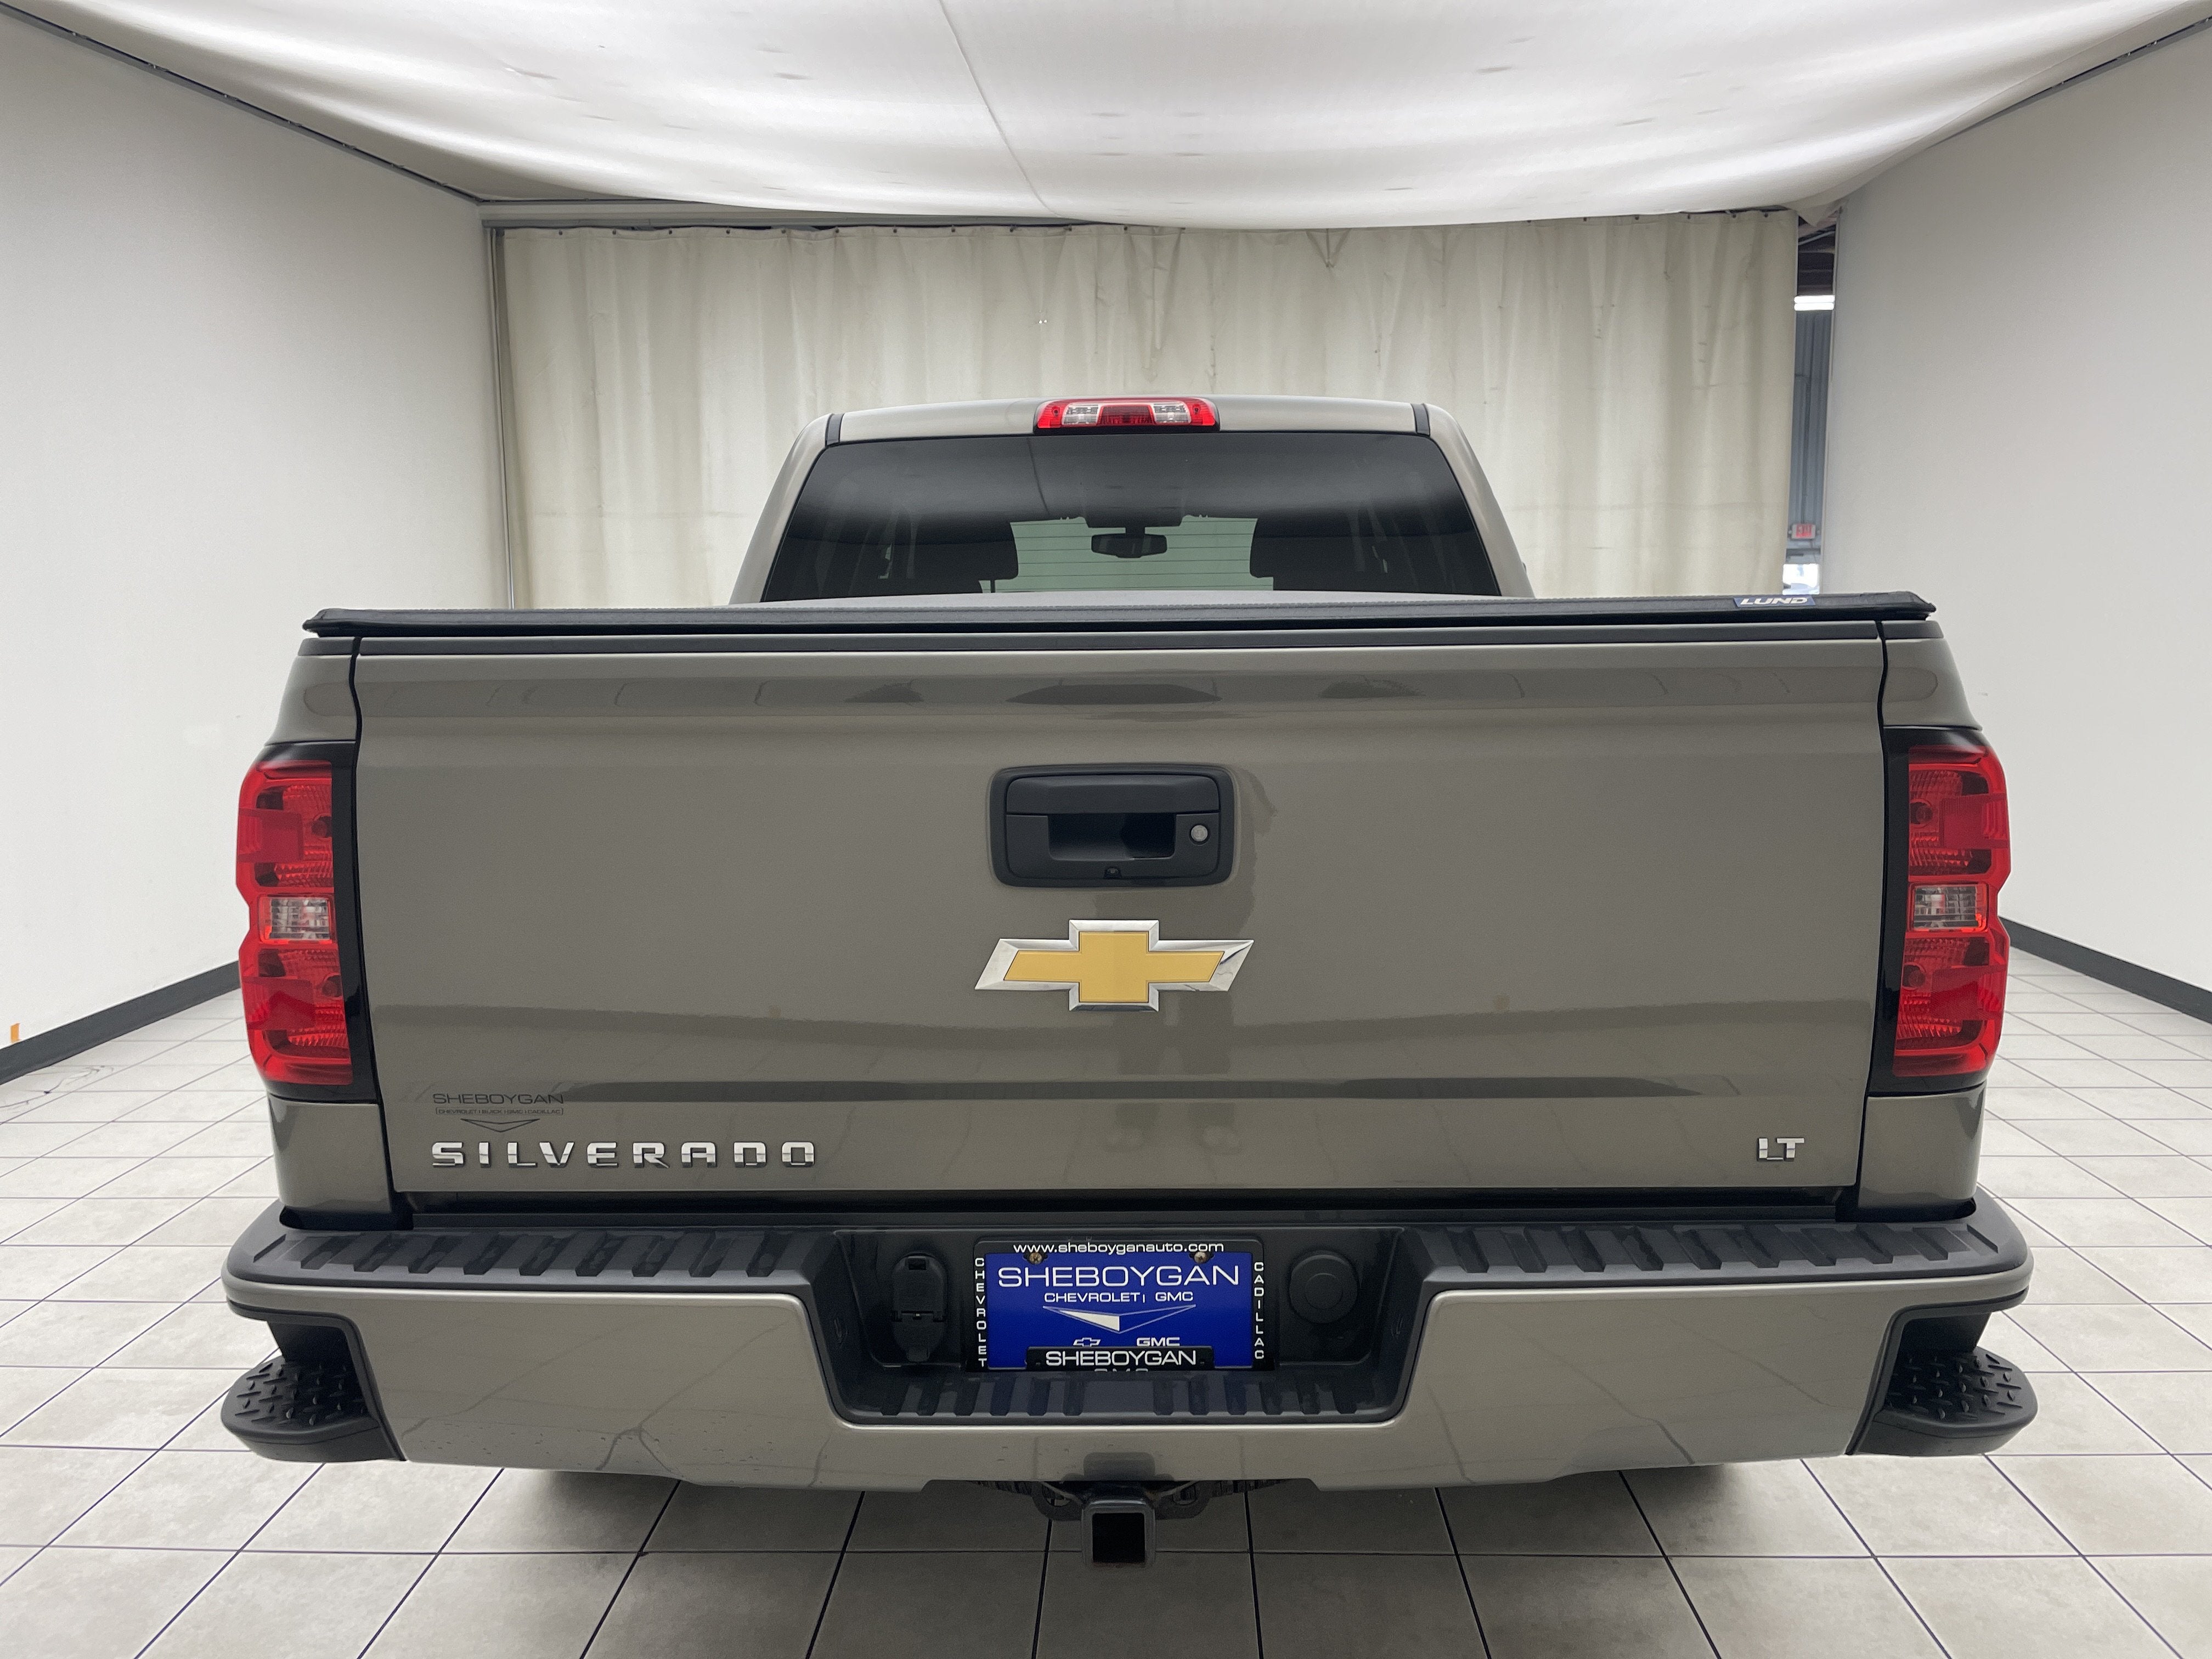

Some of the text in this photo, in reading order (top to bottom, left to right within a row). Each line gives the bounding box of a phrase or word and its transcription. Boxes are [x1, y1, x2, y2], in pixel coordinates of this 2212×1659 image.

[1740, 597, 1808, 605] LUND
[433, 1093, 564, 1104] SHEBOYGAN
[432, 1141, 816, 1169] SILVERADO
[1757, 1137, 1805, 1161] LT
[1013, 1242, 1224, 1255] www.sheboyganauto.com
[998, 1265, 1239, 1288] SHEBOYGAN
[1044, 1291, 1194, 1303] CHEVROLET GMC
[975, 1257, 987, 1367] CHEVROLET
[1254, 1262, 1265, 1359] CADILLAC
[1136, 1337, 1180, 1347] GMC
[1046, 1350, 1197, 1366] SHEBOYGAN
